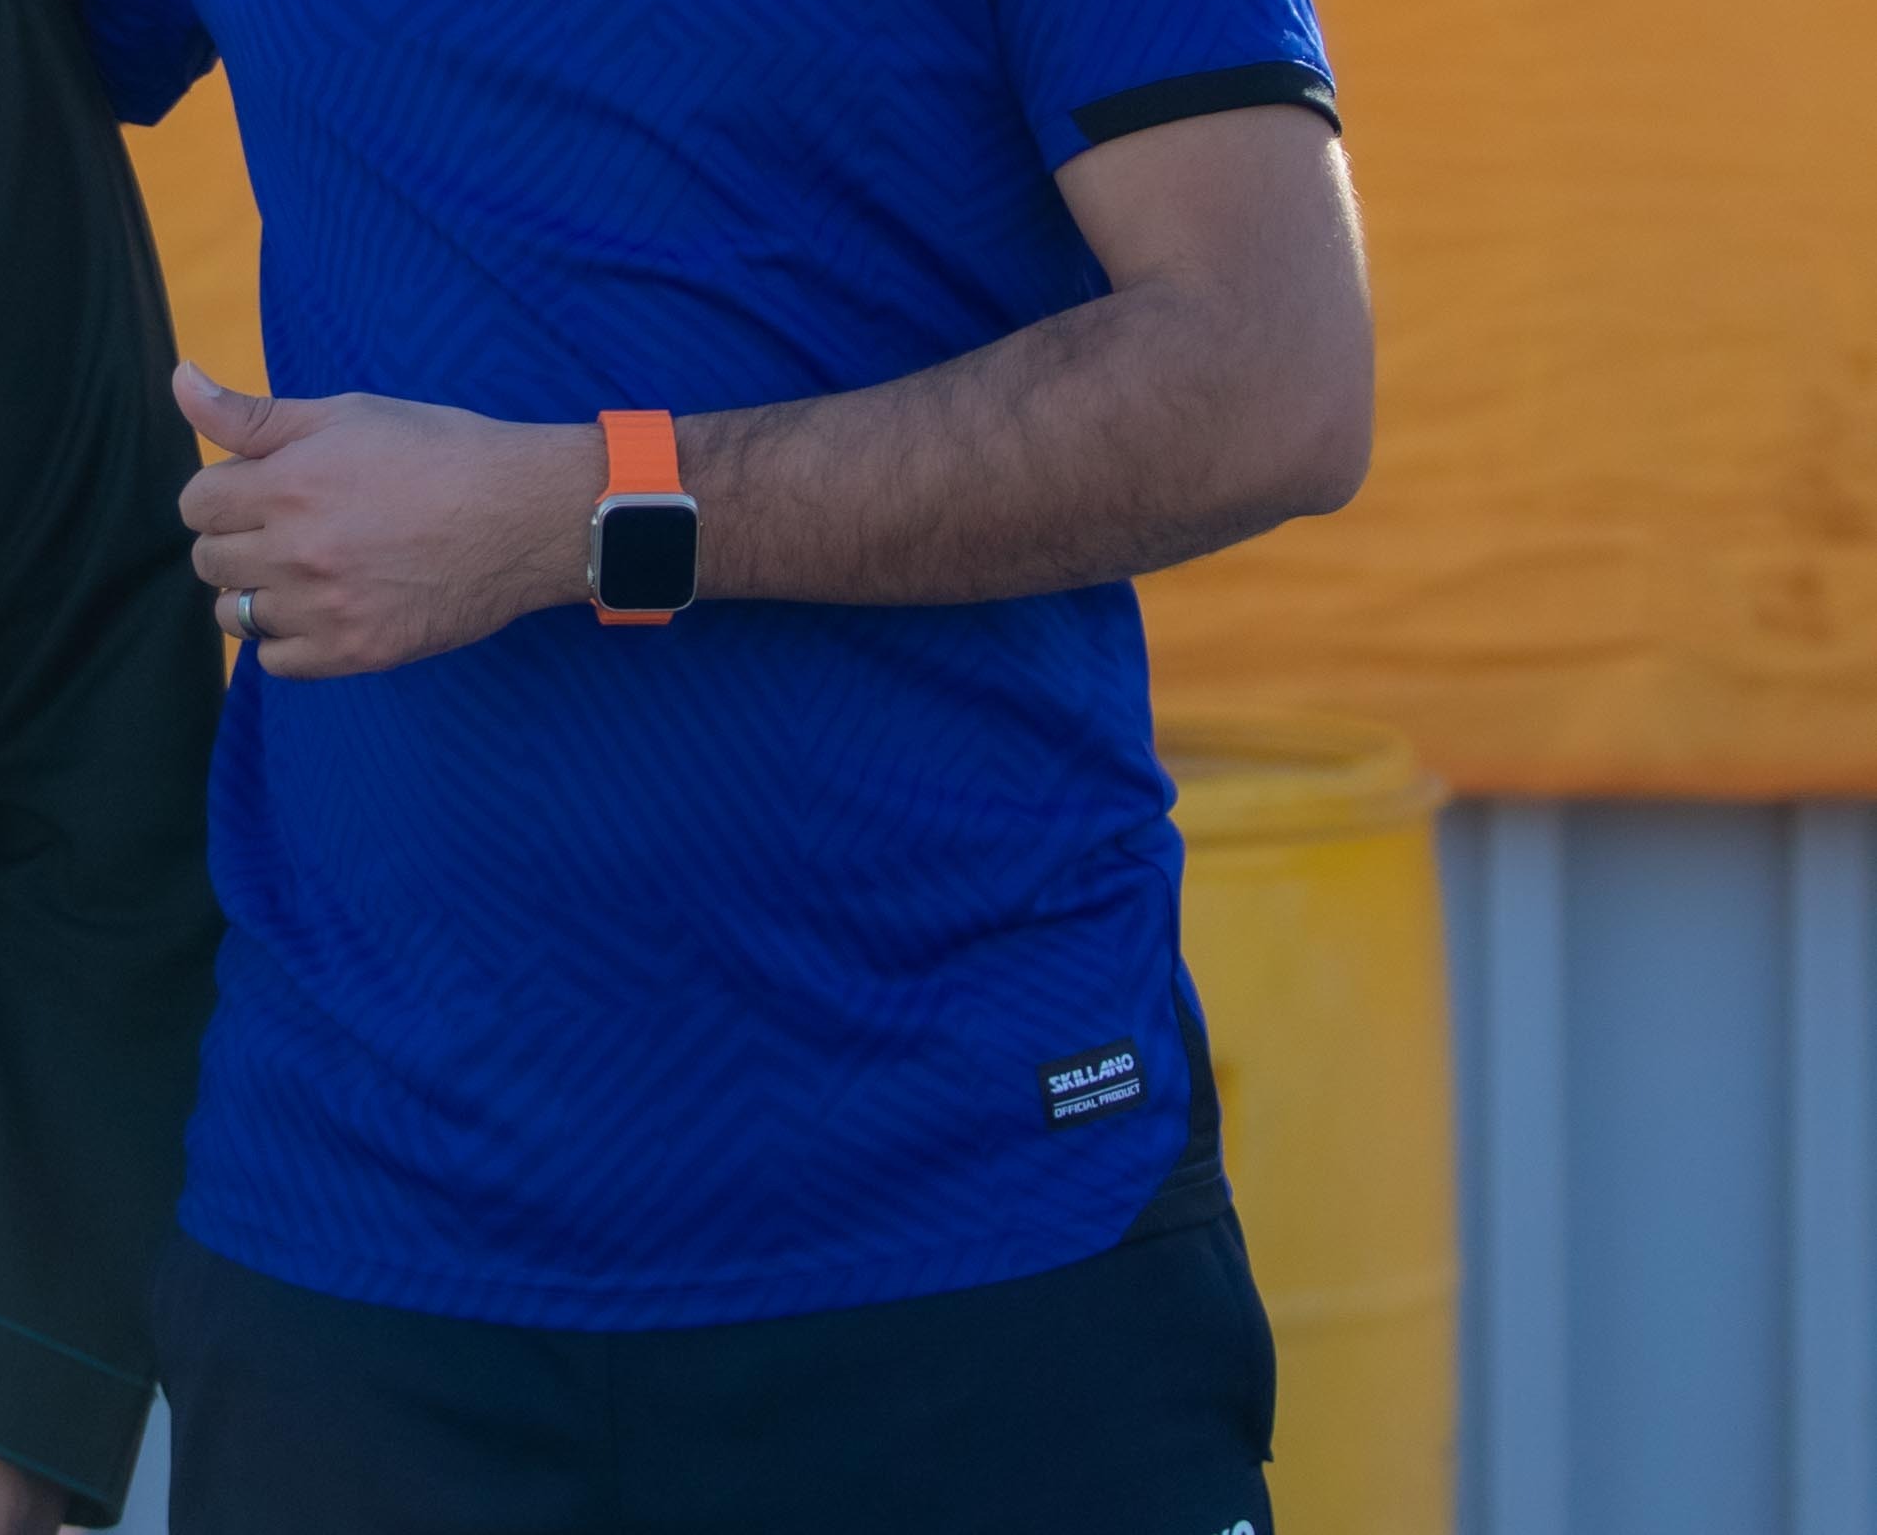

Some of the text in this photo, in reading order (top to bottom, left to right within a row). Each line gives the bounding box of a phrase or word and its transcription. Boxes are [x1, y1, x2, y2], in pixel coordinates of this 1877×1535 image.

[1048, 1053, 1134, 1094] SKILLANO
[1054, 1082, 1141, 1119] OFFICIAL PRODUCT
